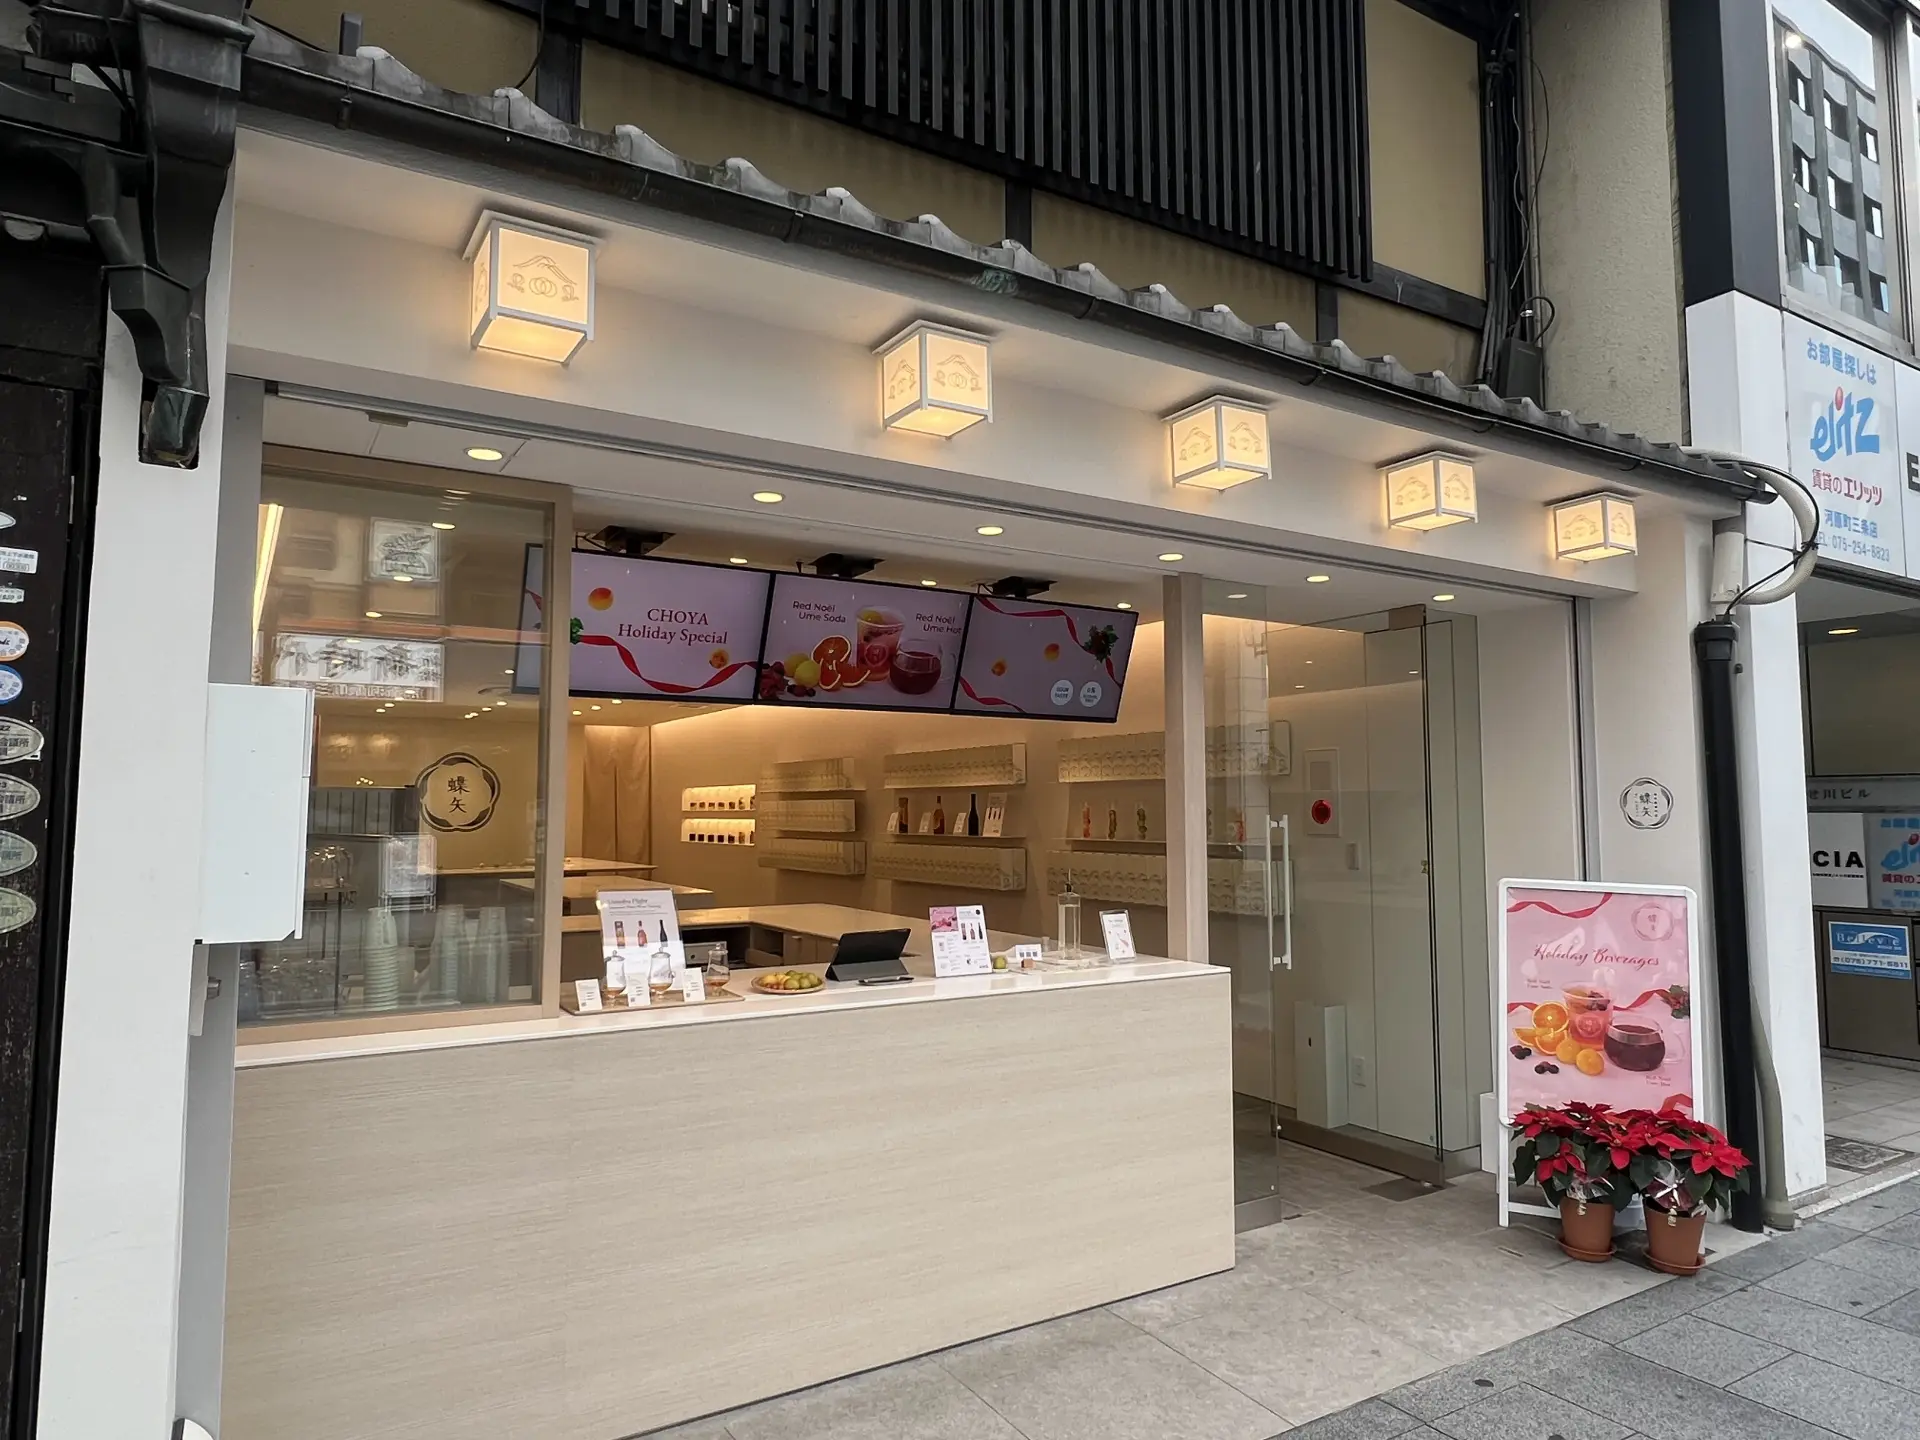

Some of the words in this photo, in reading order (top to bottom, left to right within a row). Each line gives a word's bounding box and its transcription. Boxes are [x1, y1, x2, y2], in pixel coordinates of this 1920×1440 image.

[1807, 337, 1877, 385] お部屋探しは
[1812, 468, 1883, 506] 賃貸のエリッツ
[1824, 508, 1878, 538] 河原町三条店
[793, 601, 812, 610] Red
[647, 608, 709, 626] CHOYA
[799, 611, 822, 621] Ume
[823, 613, 846, 623] Soda
[916, 613, 933, 622] Red
[618, 624, 676, 645] Holiday
[680, 628, 728, 647] Special
[923, 624, 944, 633] Ume
[1534, 944, 1588, 967] Holiday
[1592, 948, 1659, 972] Beverages
